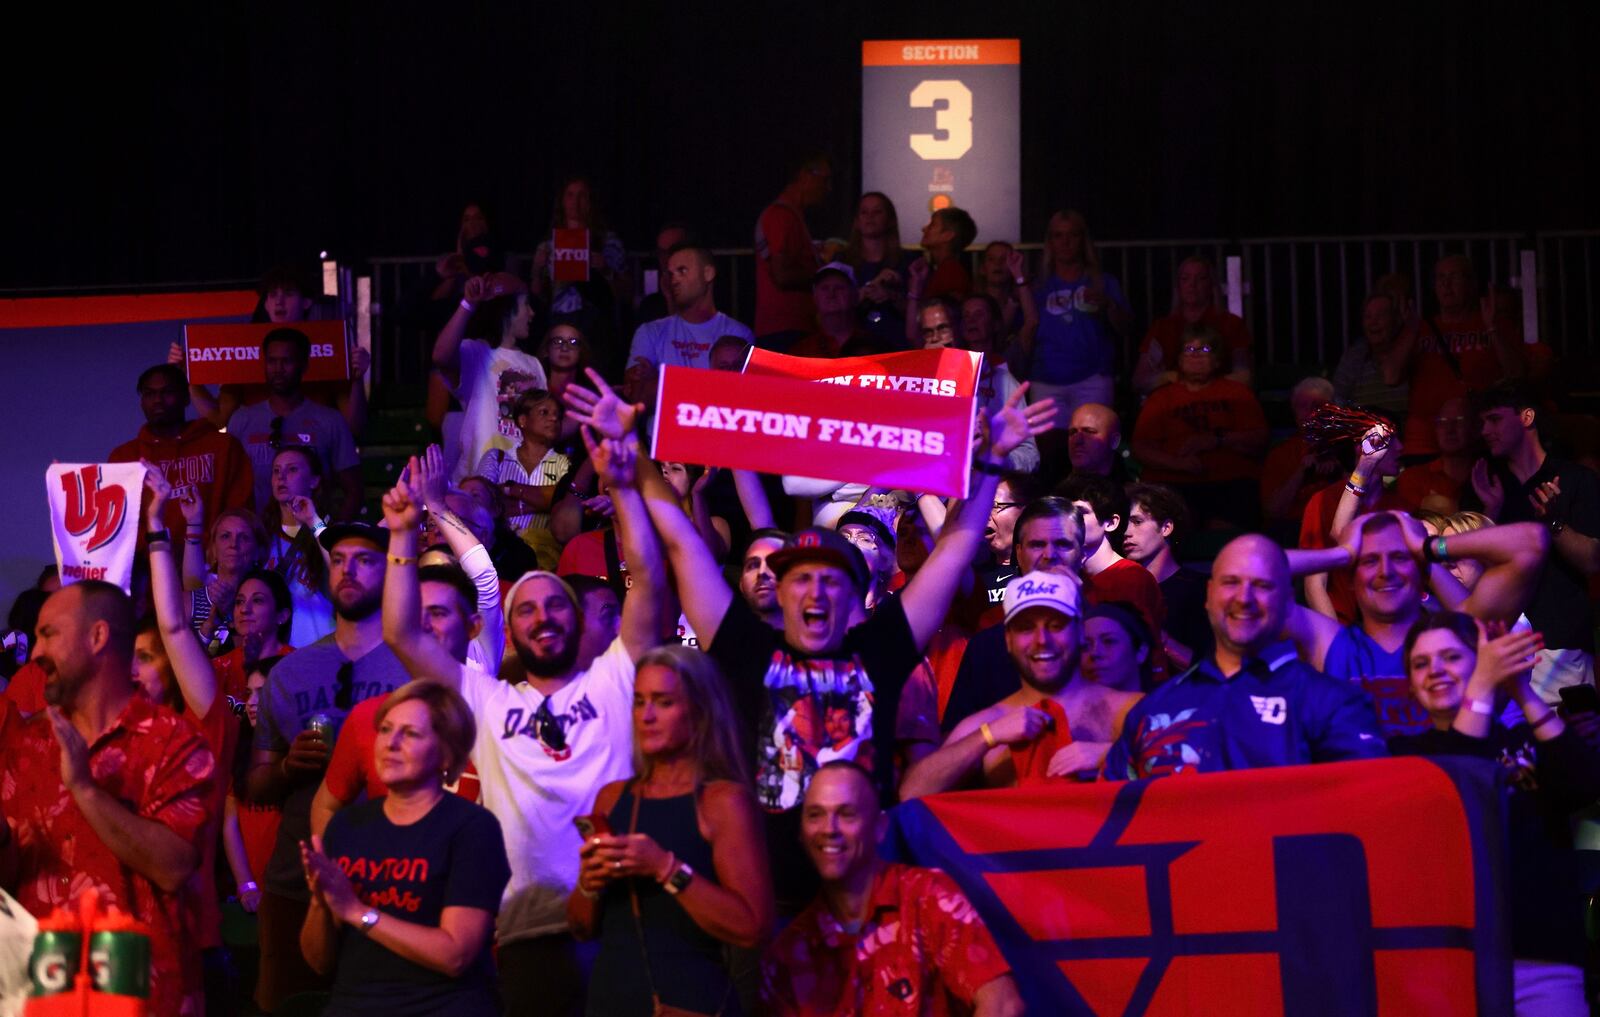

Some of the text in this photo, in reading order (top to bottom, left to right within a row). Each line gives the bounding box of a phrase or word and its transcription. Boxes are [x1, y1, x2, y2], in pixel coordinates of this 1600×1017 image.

[902, 45, 980, 60] SECTION
[909, 80, 973, 160] 3
[190, 346, 261, 362] DAYTON
[858, 375, 957, 397] FLYERS
[676, 402, 946, 456] DAYTON FLYERS
[158, 453, 216, 488] YTON
[61, 464, 127, 554] UD
[63, 560, 107, 581] meijer
